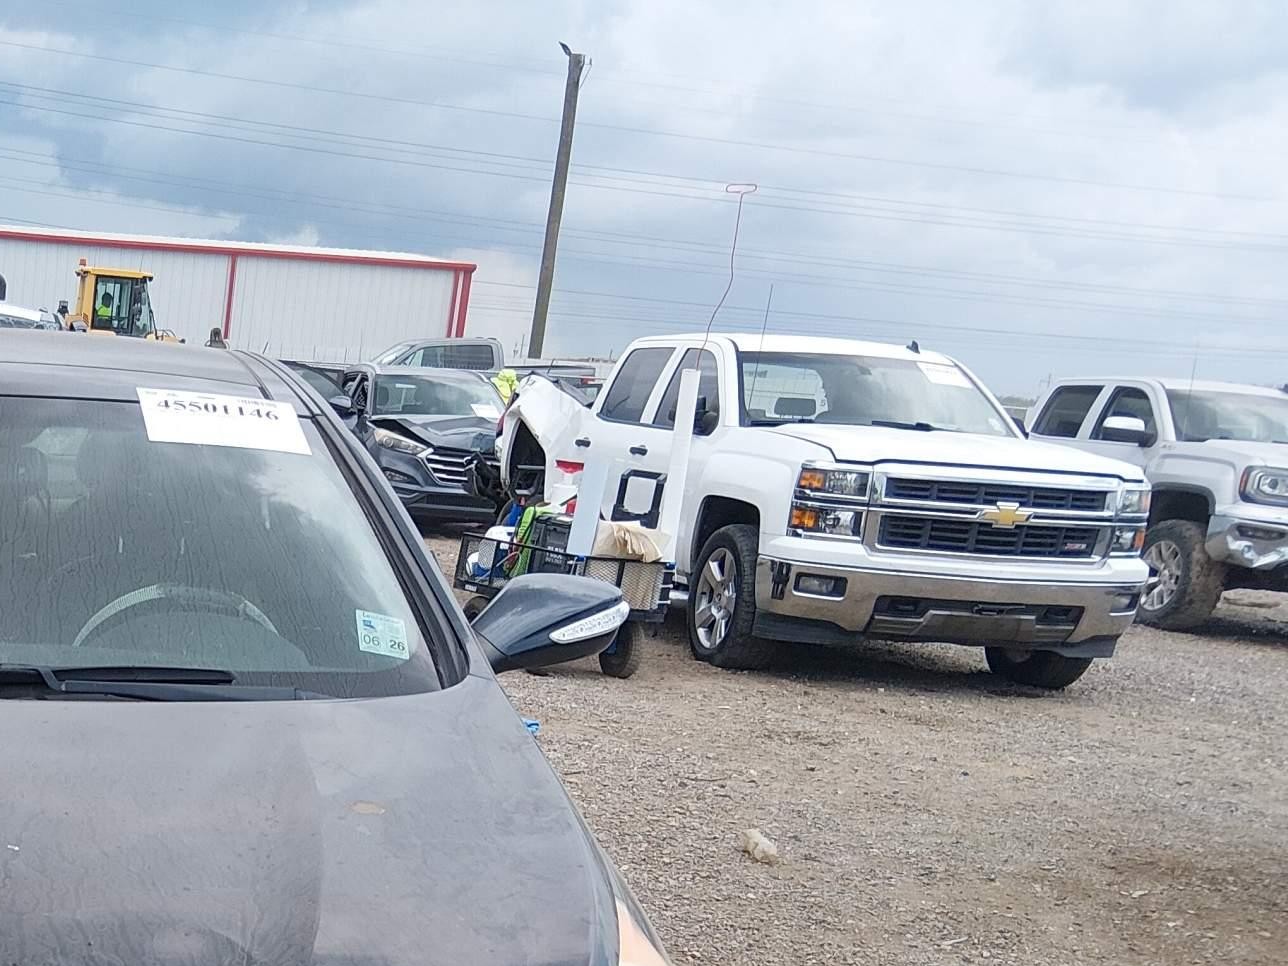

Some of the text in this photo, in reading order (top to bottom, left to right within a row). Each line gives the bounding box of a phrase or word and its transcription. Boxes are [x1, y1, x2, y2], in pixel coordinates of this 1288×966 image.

[157, 399, 279, 421] 45501146
[363, 634, 380, 647] 06
[389, 639, 405, 652] 26
